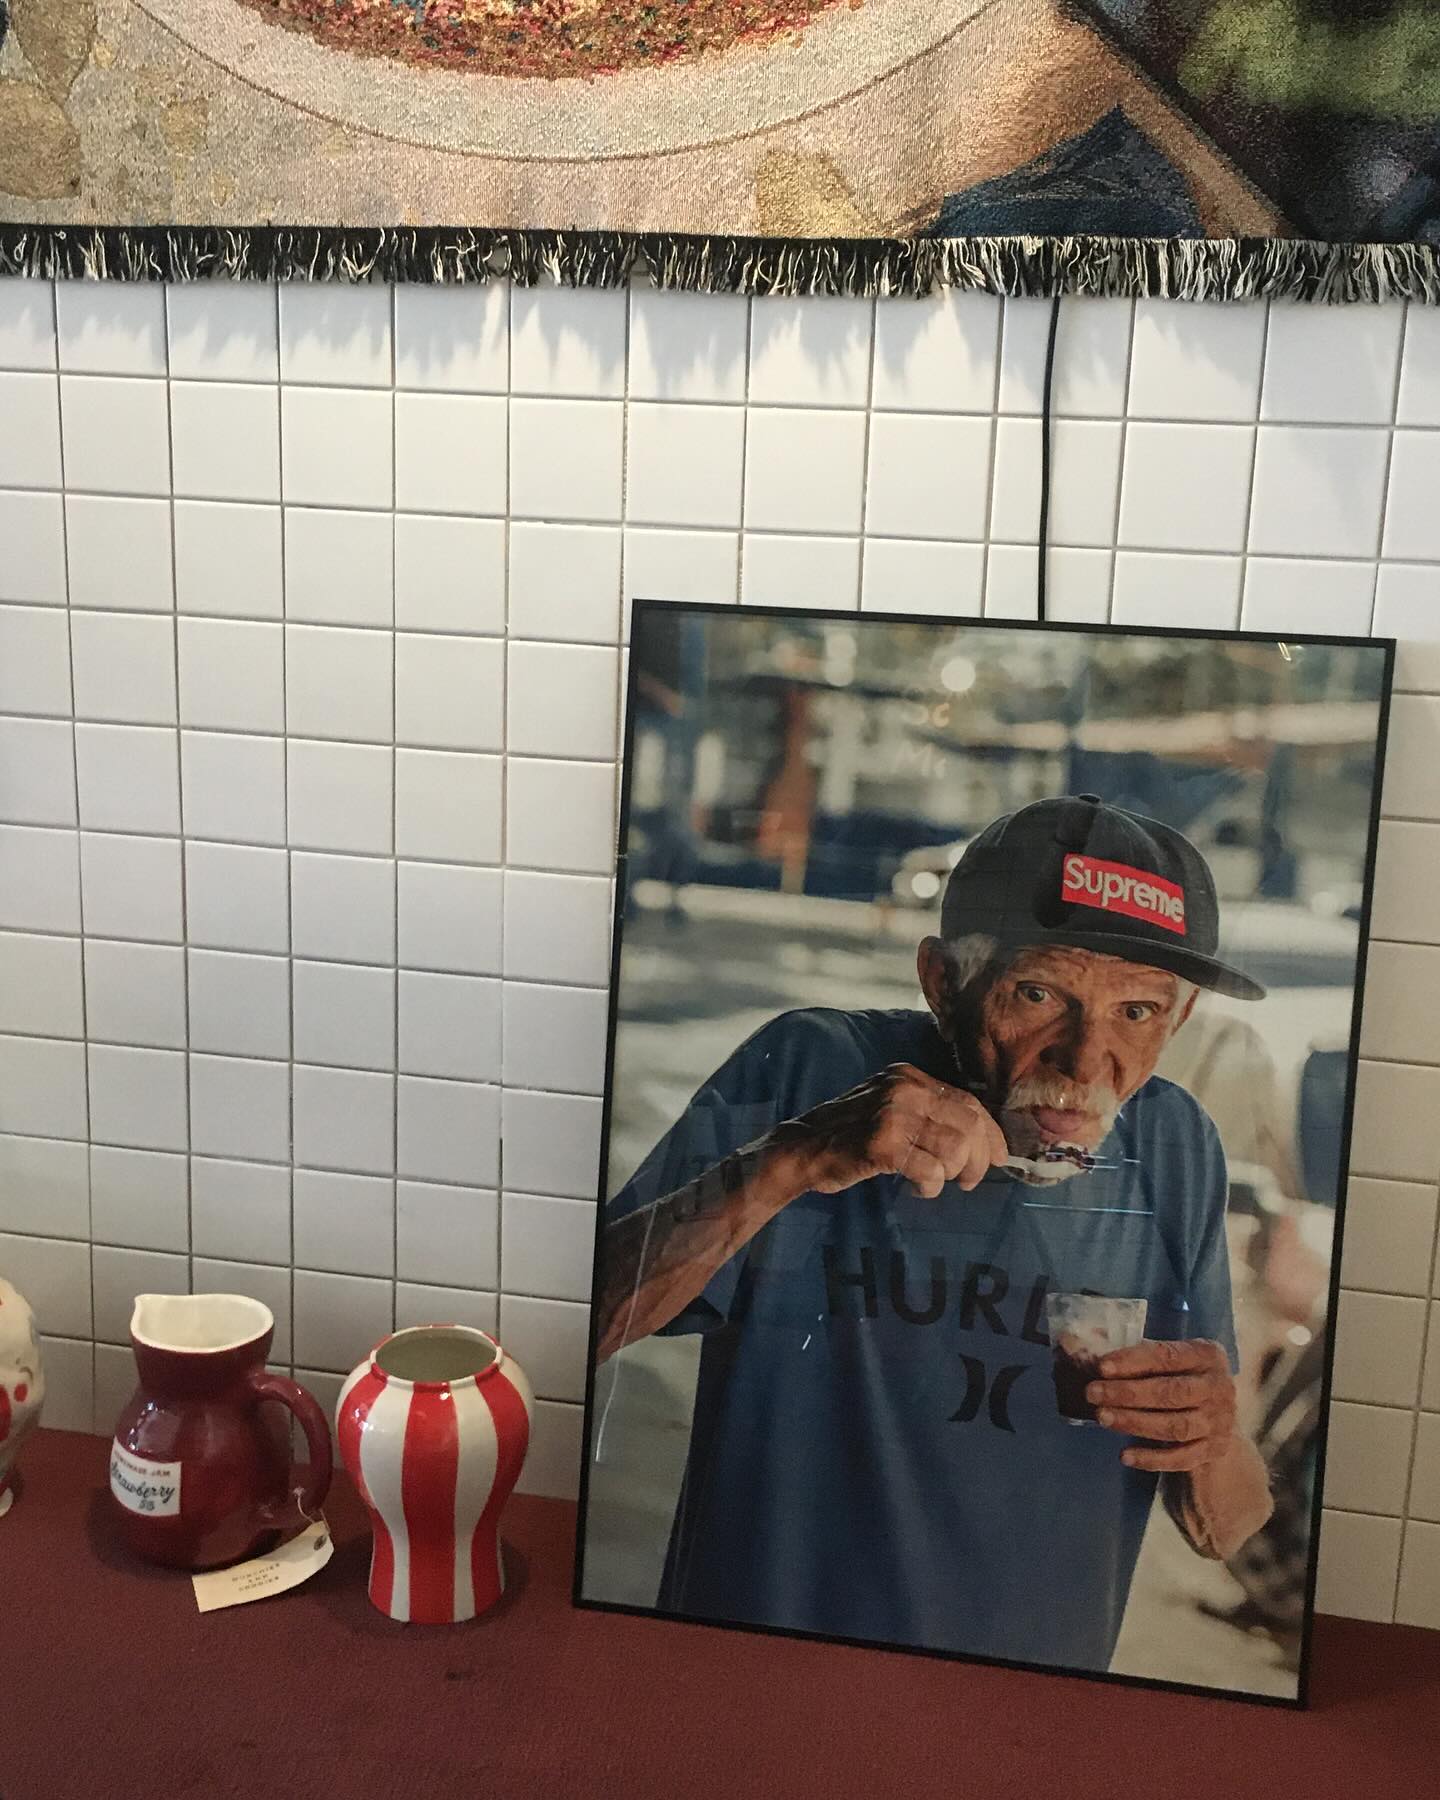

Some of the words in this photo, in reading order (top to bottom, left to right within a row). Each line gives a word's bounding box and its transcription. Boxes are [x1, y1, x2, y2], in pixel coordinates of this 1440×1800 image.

[1063, 857, 1185, 923] Supreme
[822, 1246, 1105, 1347] HURL
[111, 1461, 176, 1504] Strawberry
